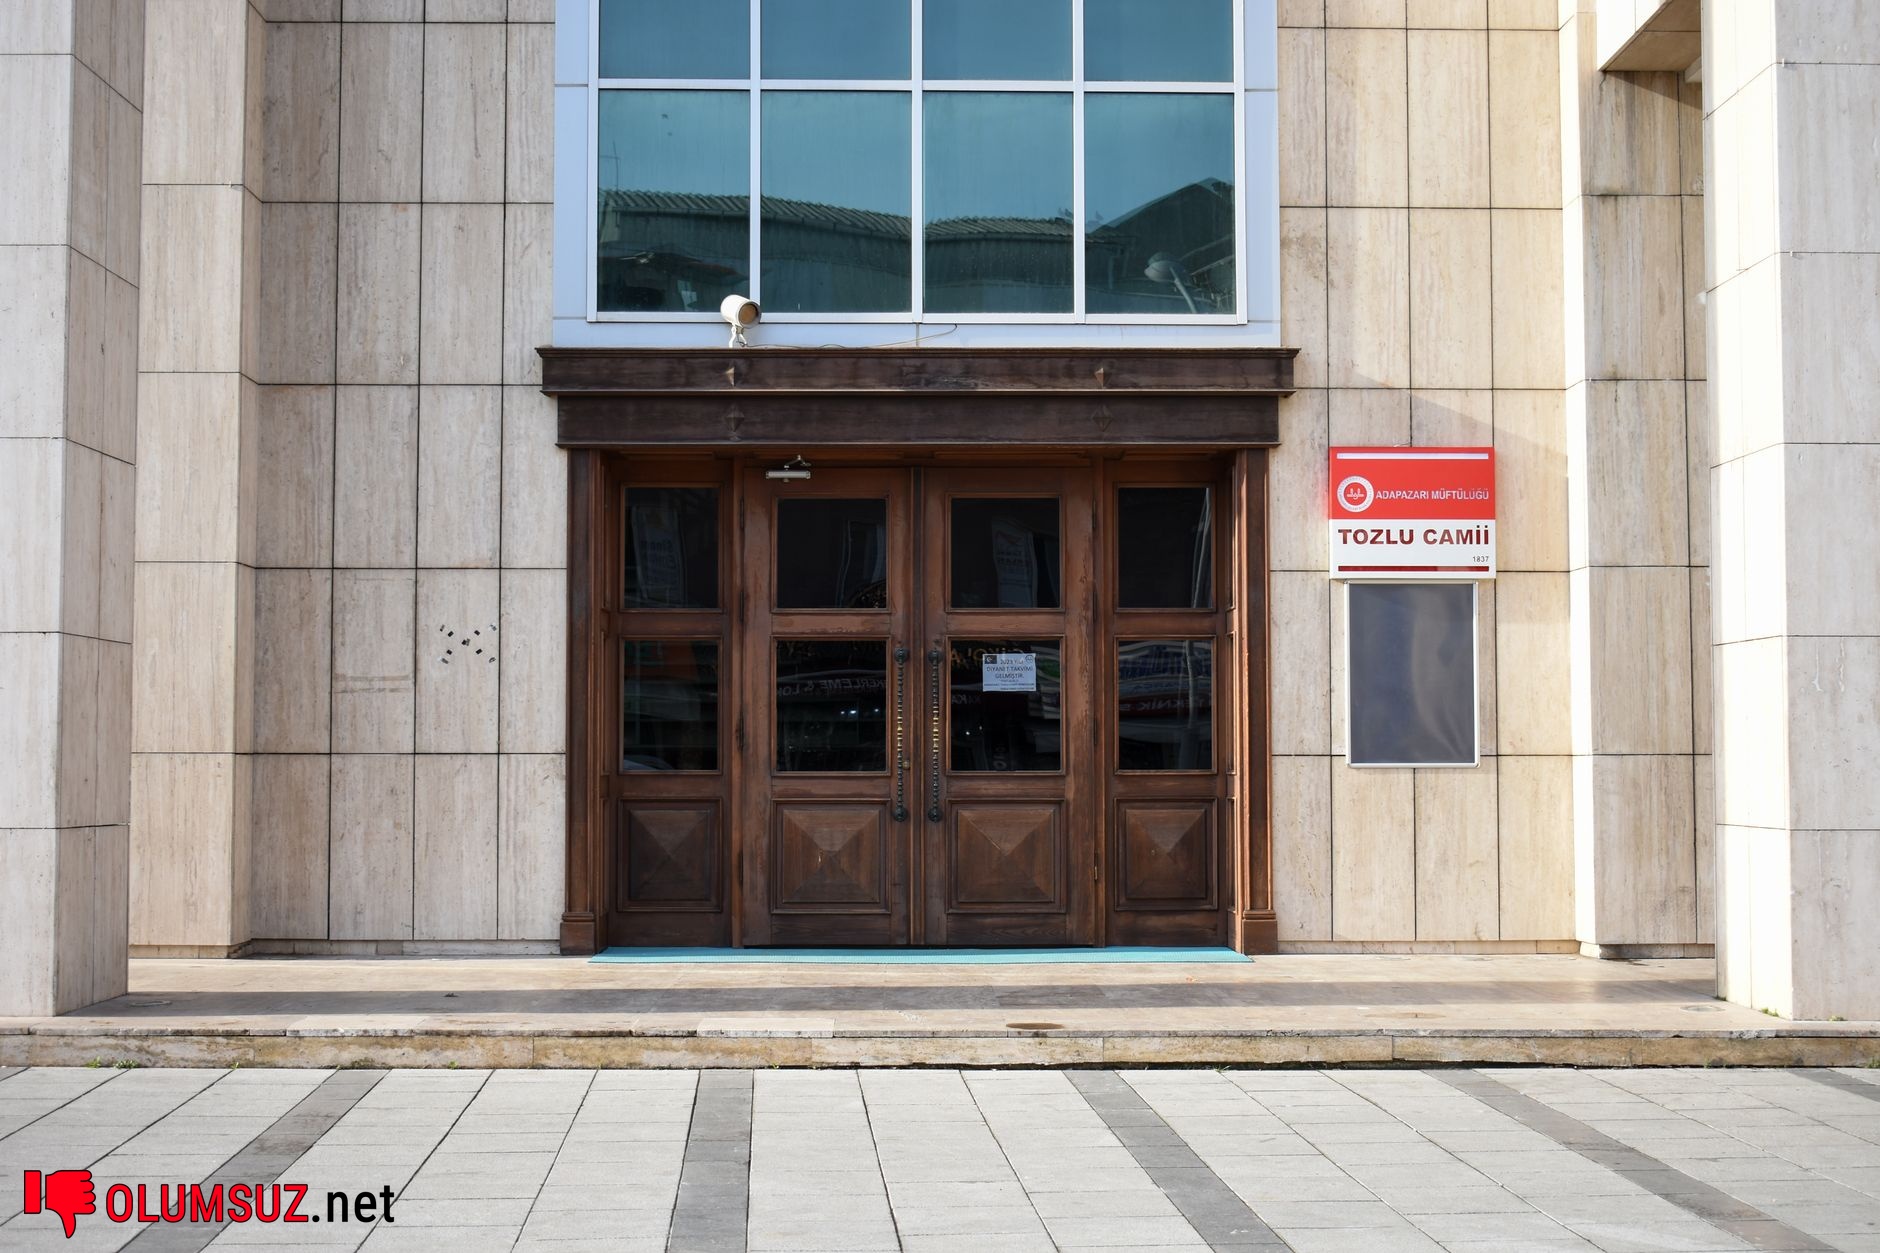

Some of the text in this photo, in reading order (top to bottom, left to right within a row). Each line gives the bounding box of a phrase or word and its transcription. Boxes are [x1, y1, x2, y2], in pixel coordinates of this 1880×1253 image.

[1375, 487, 1489, 500] ADAPAZARI MÜFTÜLÜĞÜ
[1338, 528, 1414, 545] TOZLU
[1472, 555, 1489, 563] 1837
